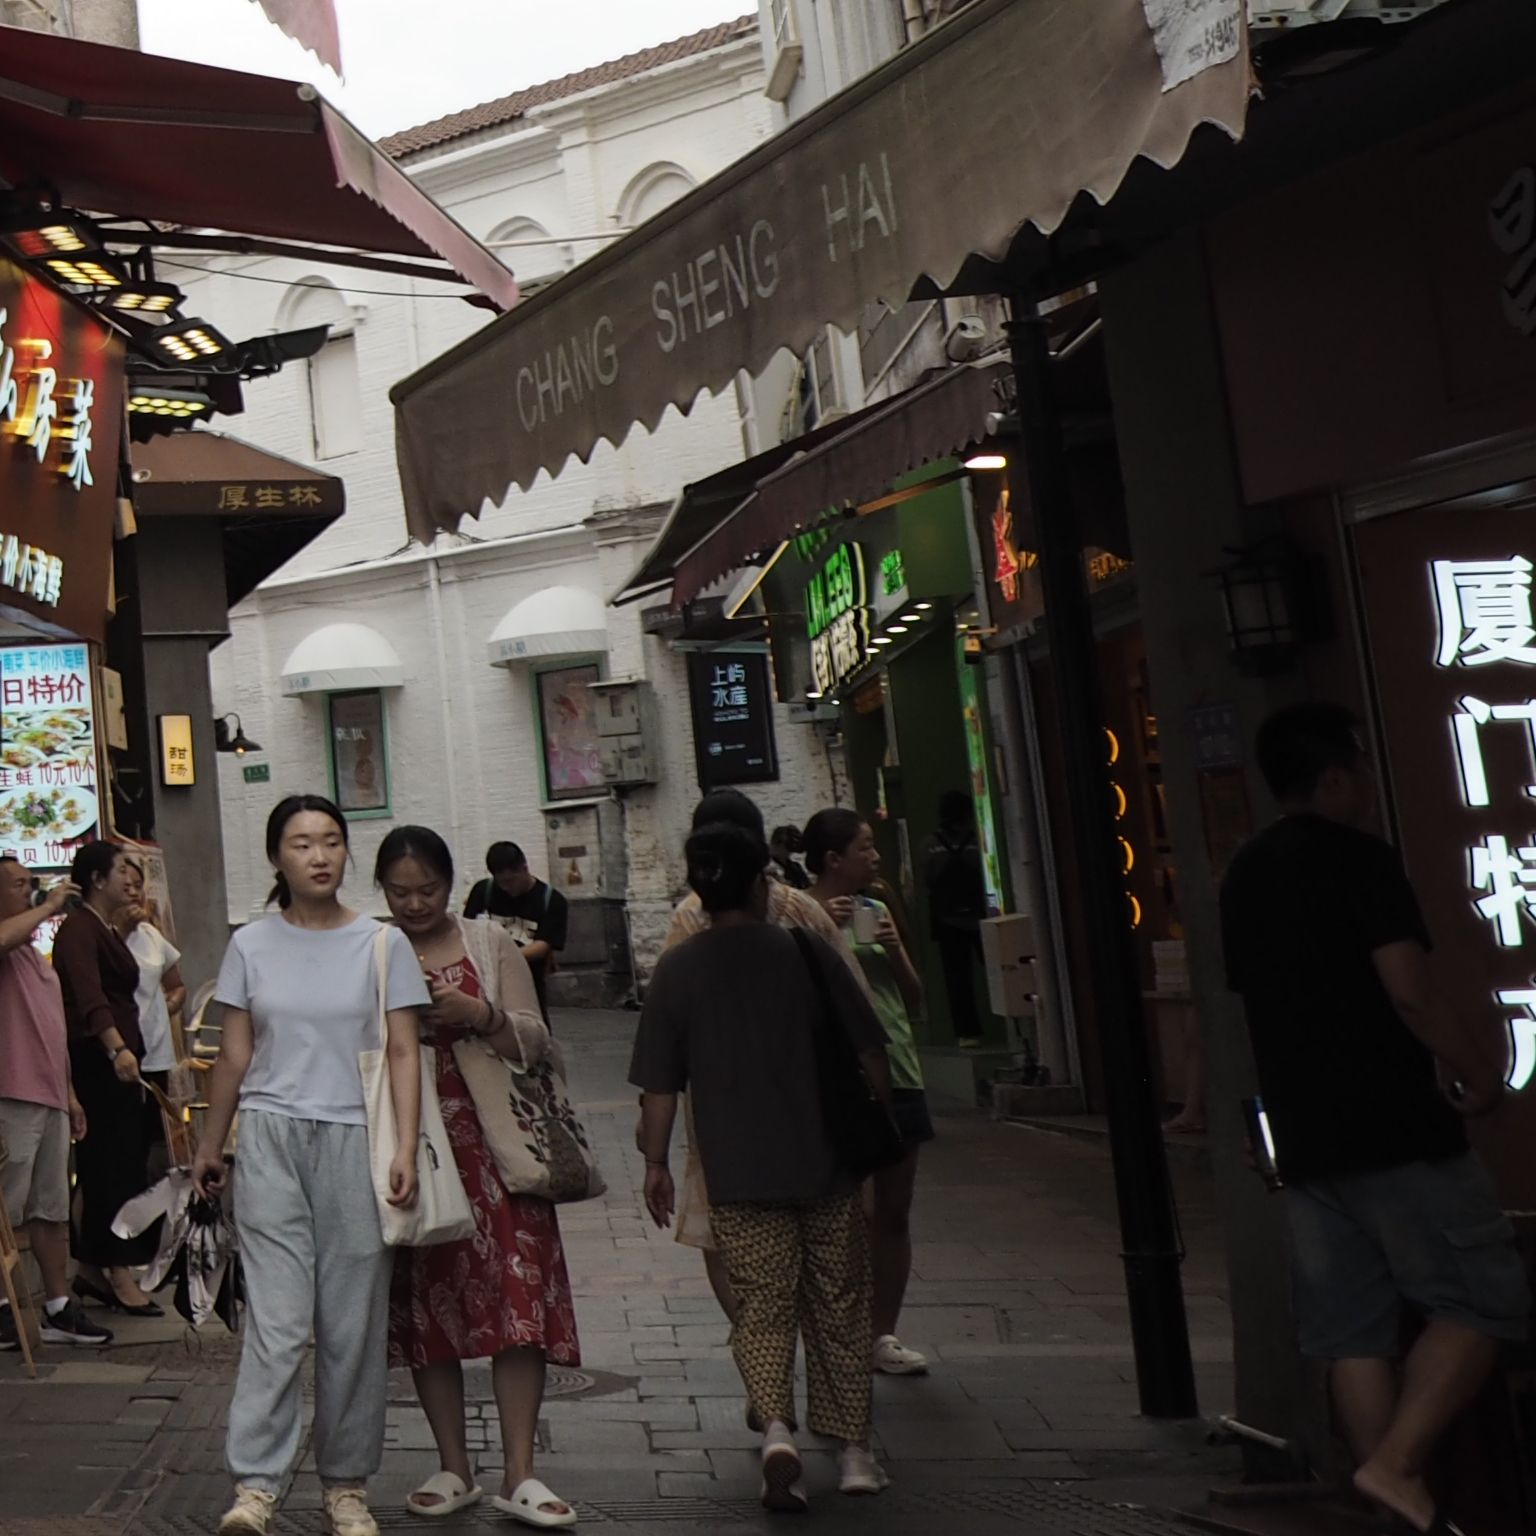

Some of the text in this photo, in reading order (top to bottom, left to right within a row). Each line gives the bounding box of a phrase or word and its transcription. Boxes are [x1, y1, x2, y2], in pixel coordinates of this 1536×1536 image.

[516, 152, 898, 433] CHANG SHENG HAI
